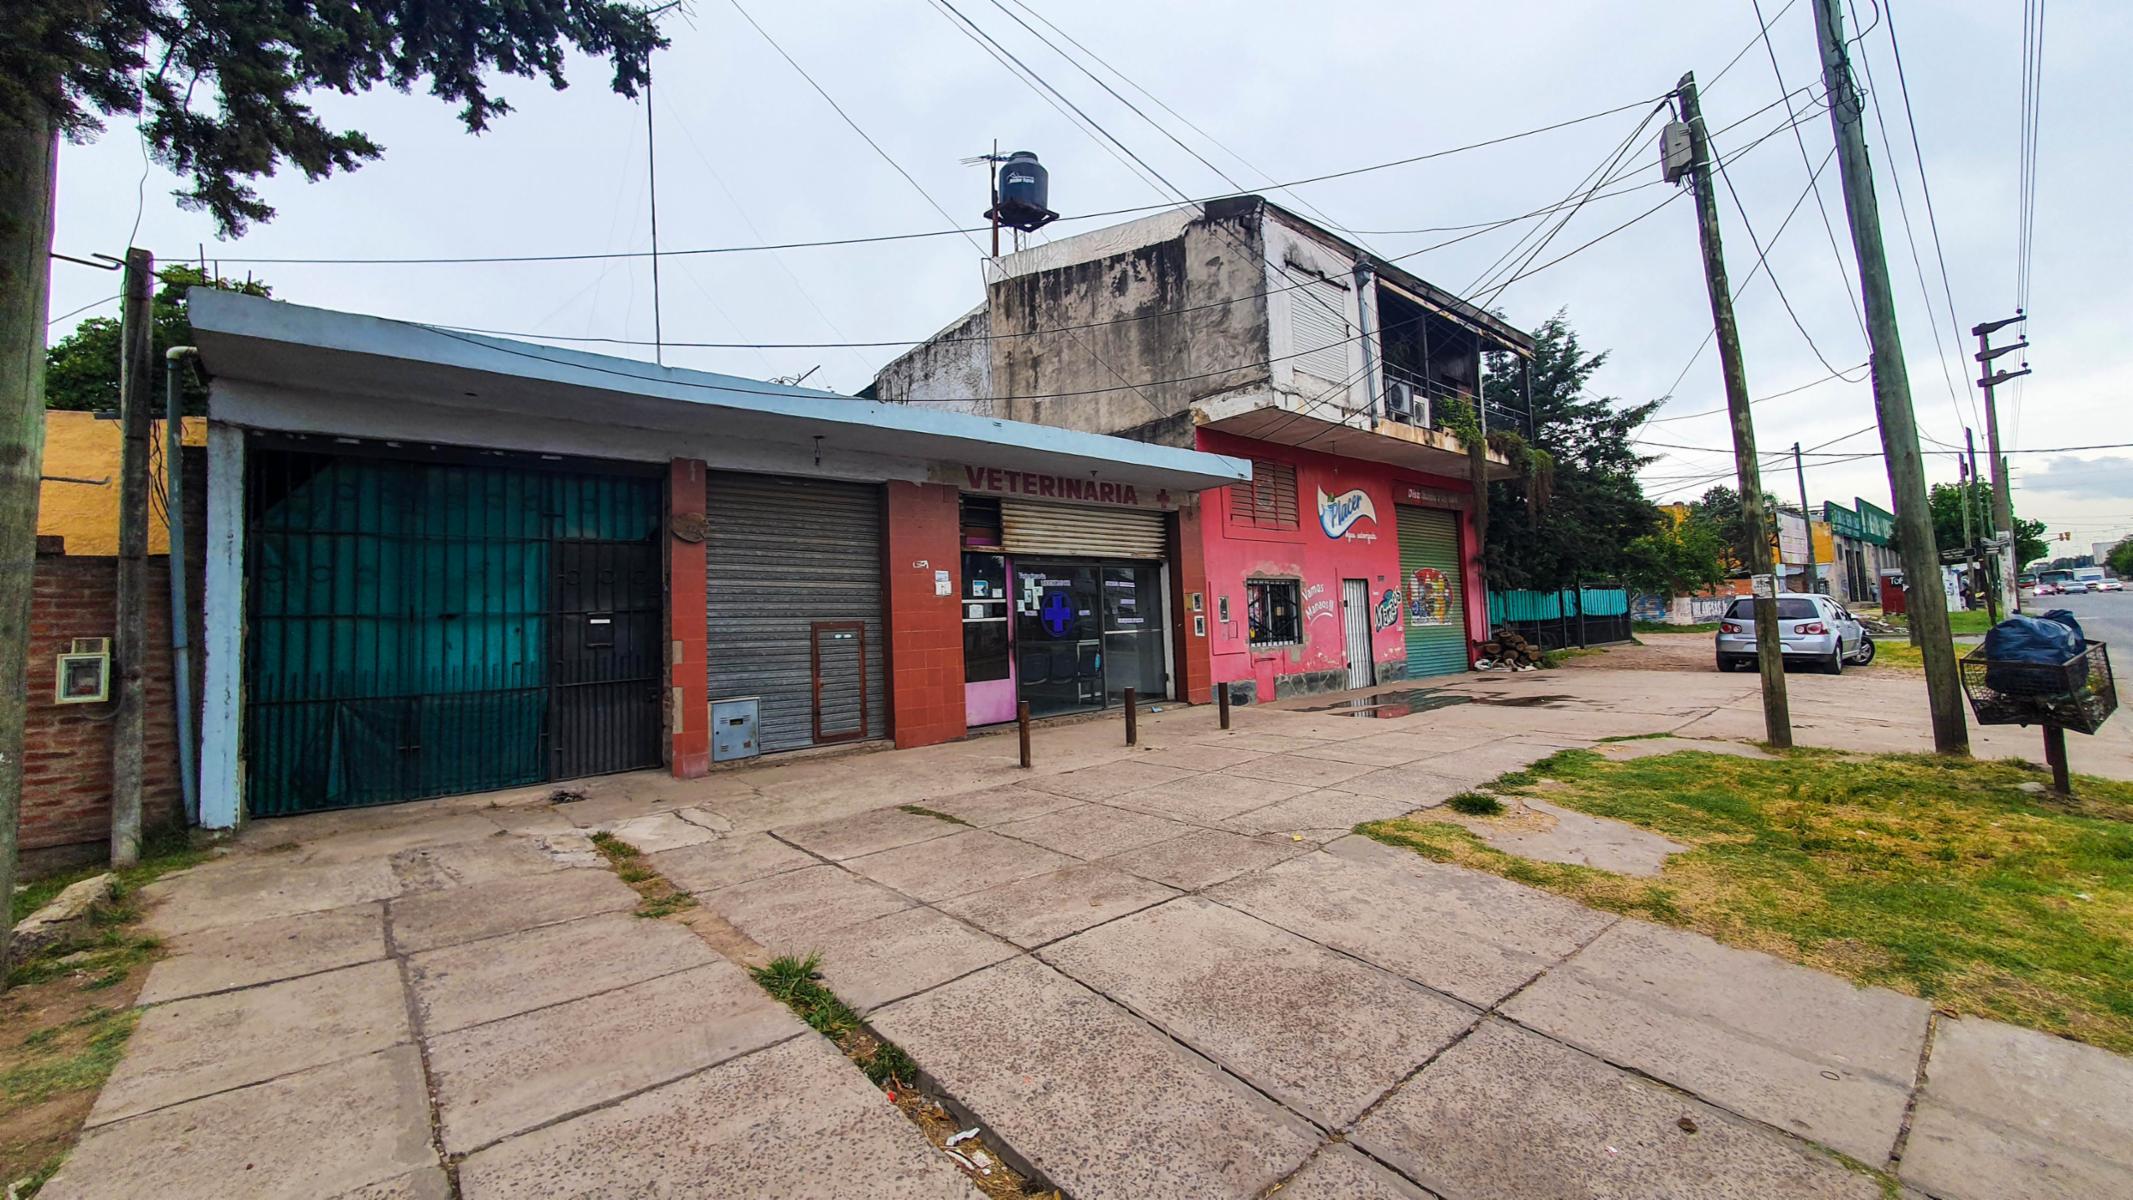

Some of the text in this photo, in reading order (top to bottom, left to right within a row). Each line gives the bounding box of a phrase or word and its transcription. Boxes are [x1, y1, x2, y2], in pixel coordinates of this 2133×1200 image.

[964, 465, 1138, 505] VETERINARIA
[1327, 494, 1362, 529] Placer
[1301, 583, 1324, 600] Vamos
